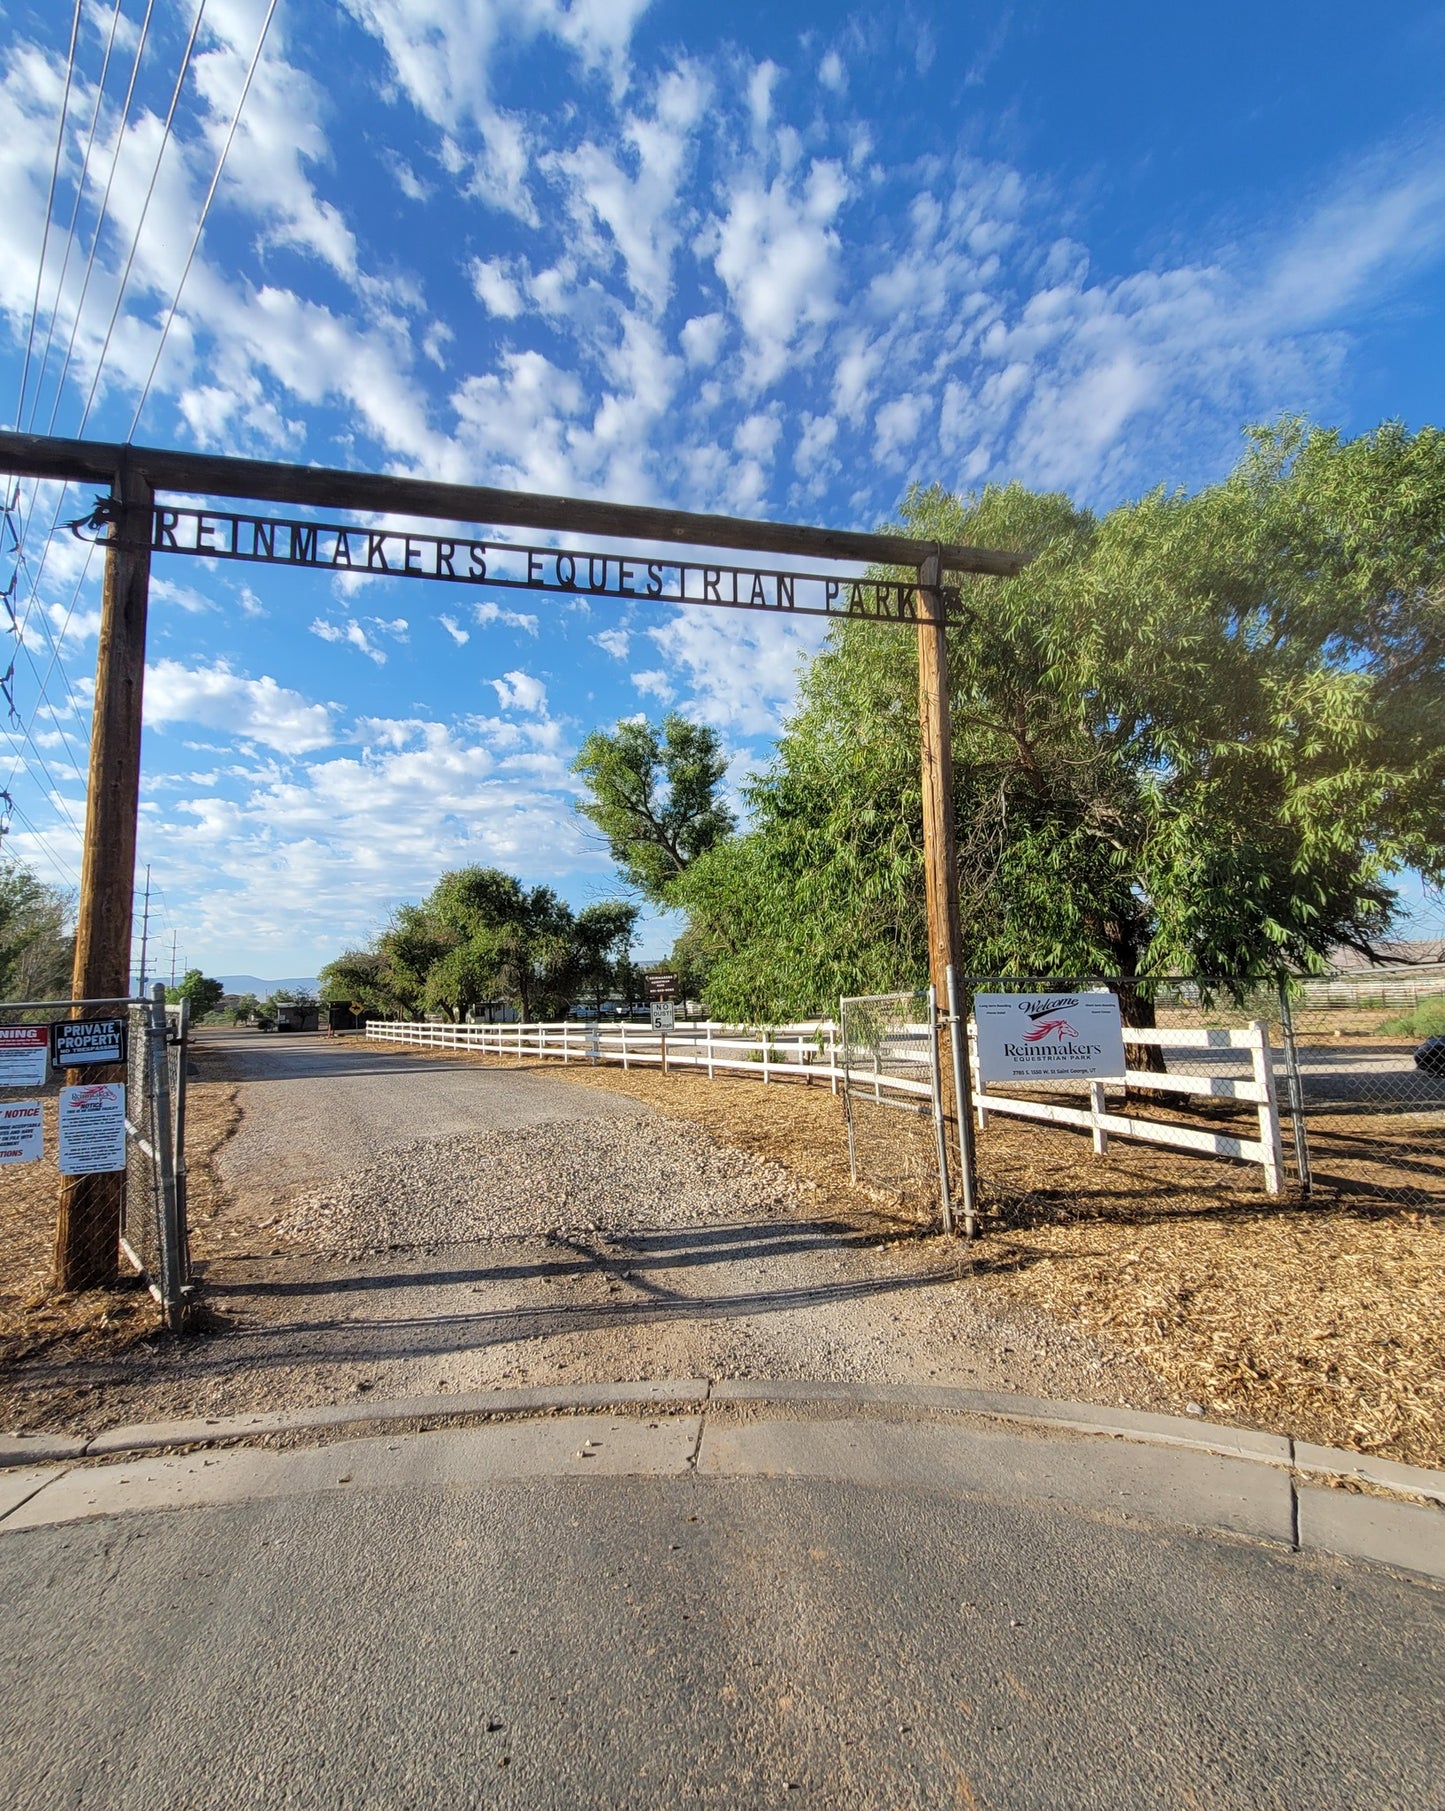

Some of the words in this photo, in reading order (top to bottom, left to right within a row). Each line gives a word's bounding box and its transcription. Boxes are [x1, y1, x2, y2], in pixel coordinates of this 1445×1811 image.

[156, 508, 486, 579] REINMAKERS
[528, 551, 795, 608] EQUESTRIAN
[826, 580, 917, 619] PARK
[1018, 998, 1079, 1014] Welcome
[64, 1022, 115, 1037] PRIVATE
[655, 1018, 662, 1028] 5
[57, 1033, 120, 1049] PROPERTY
[73, 1044, 119, 1053] TRESPASSING
[1004, 1042, 1101, 1057] Reinmakers
[5, 1107, 40, 1118] NOTICE
[80, 1101, 104, 1109] NOTICE
